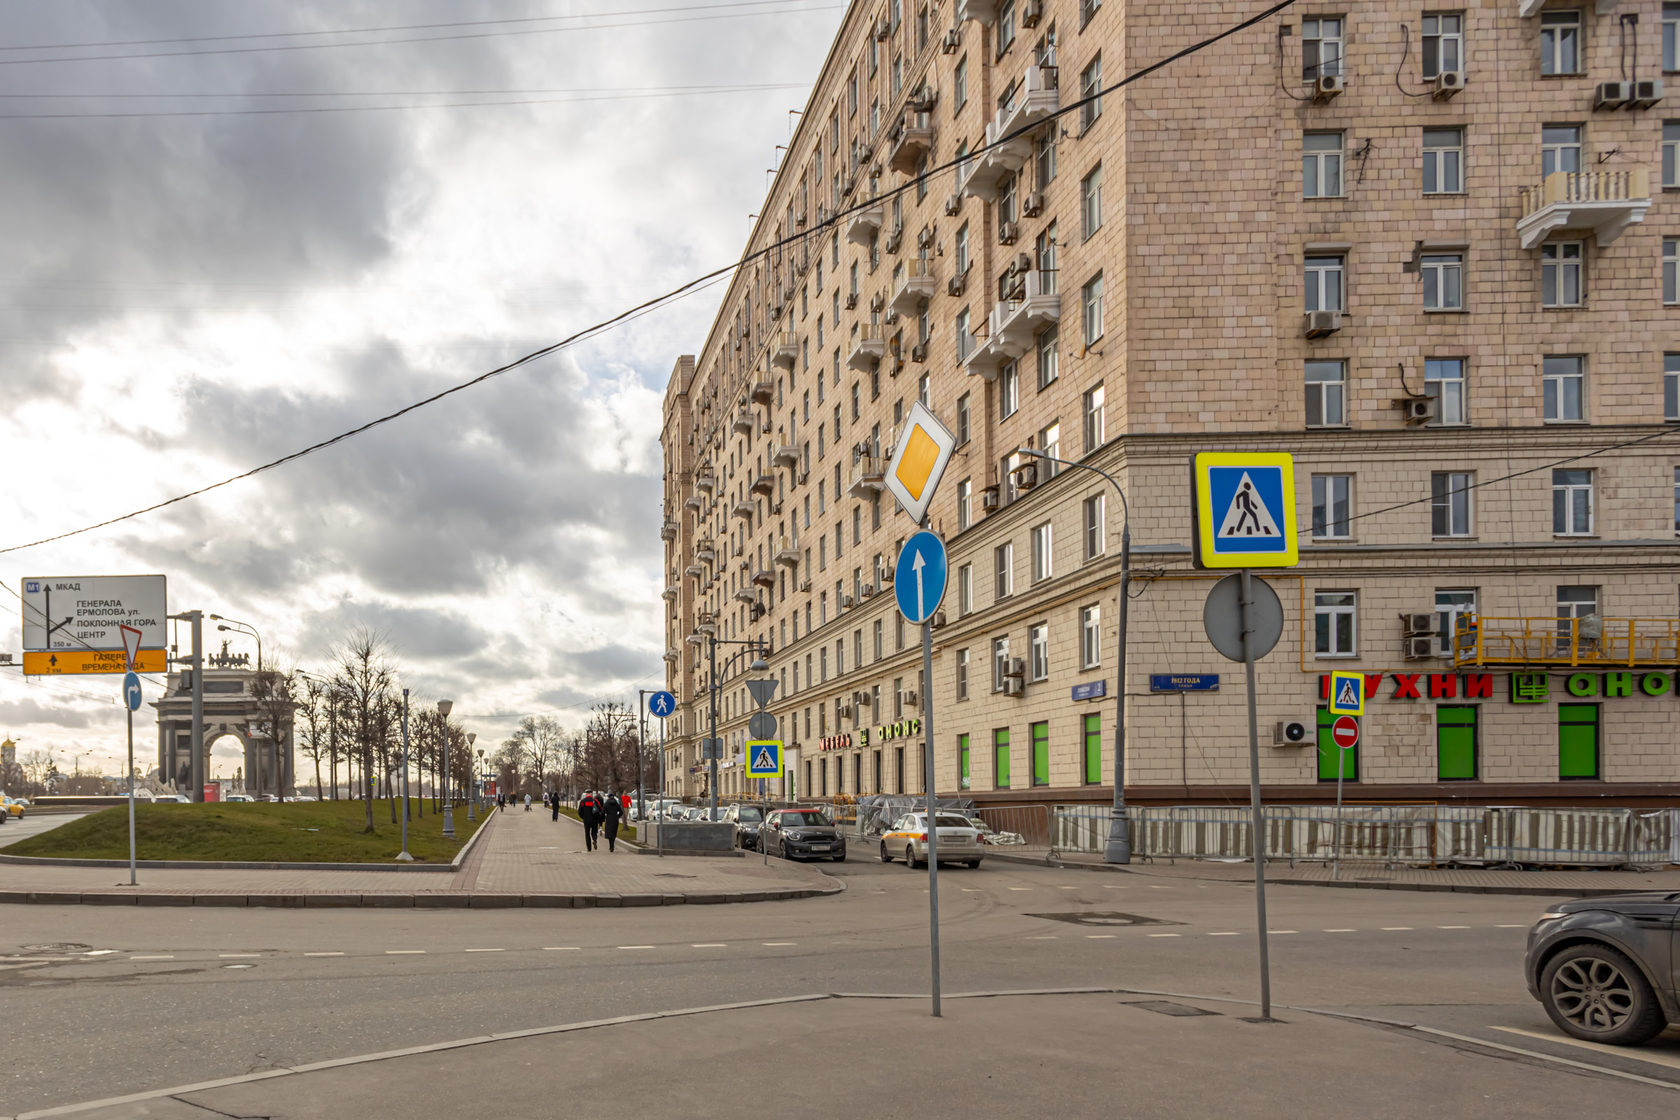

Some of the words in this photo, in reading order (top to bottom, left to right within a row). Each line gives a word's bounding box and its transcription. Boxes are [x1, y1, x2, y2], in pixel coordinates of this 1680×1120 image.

[27, 583, 40, 592] М1
[55, 583, 81, 591] МКАД
[76, 600, 122, 608] ГЕНЕРАЛА
[76, 608, 126, 617] ЕРМОЛОВА
[127, 609, 141, 617] ул.
[134, 618, 157, 627] ГОРА
[77, 630, 106, 639] ЦЕНТР
[93, 653, 127, 661] ГАЛЕРЕ
[82, 662, 121, 671] ВРЕМЕНА
[819, 734, 852, 751] МЕБЕЛЬ
